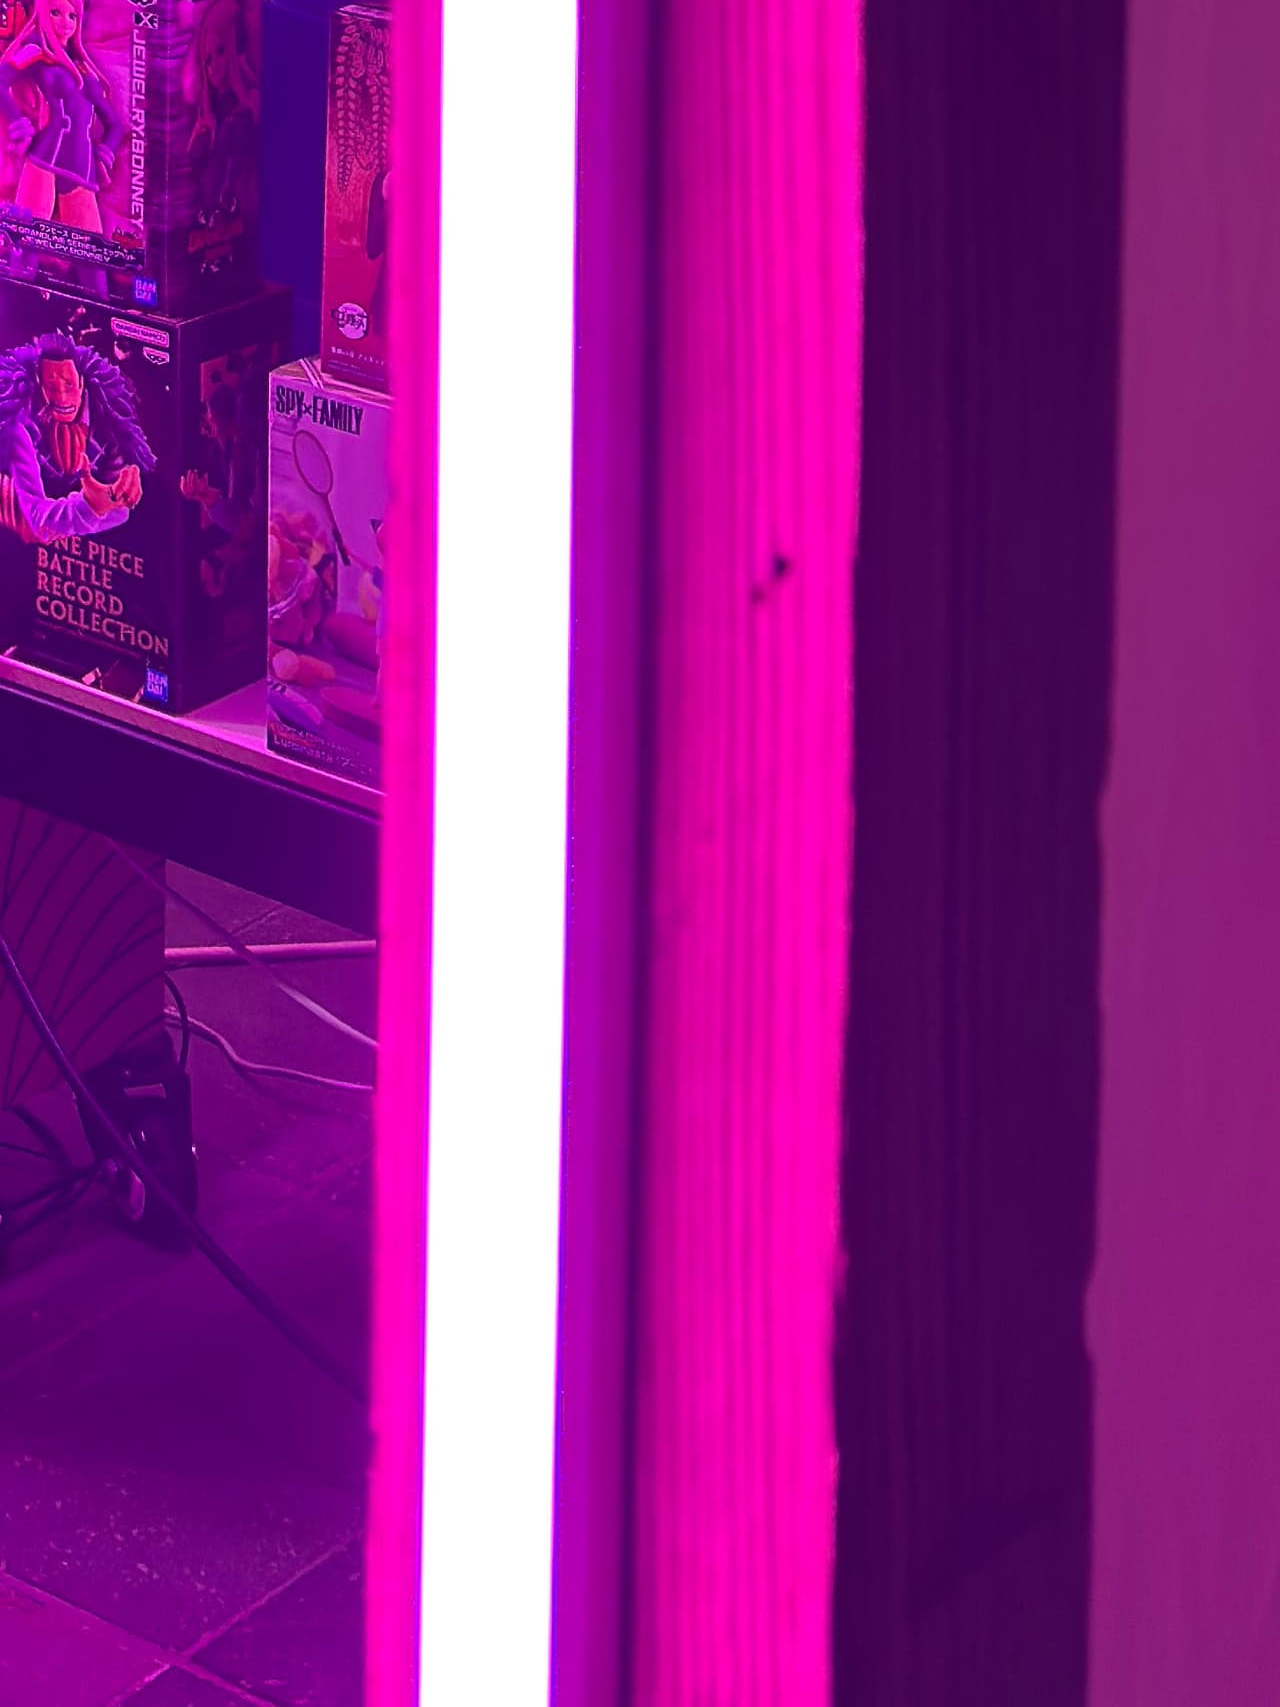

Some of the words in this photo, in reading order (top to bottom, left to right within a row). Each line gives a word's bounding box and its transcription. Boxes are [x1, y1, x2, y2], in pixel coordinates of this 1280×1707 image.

[37, 546, 113, 591] BATTLE
[88, 540, 145, 579] PIECE
[36, 570, 124, 617] RECORD
[35, 595, 170, 657] COLLECTION
